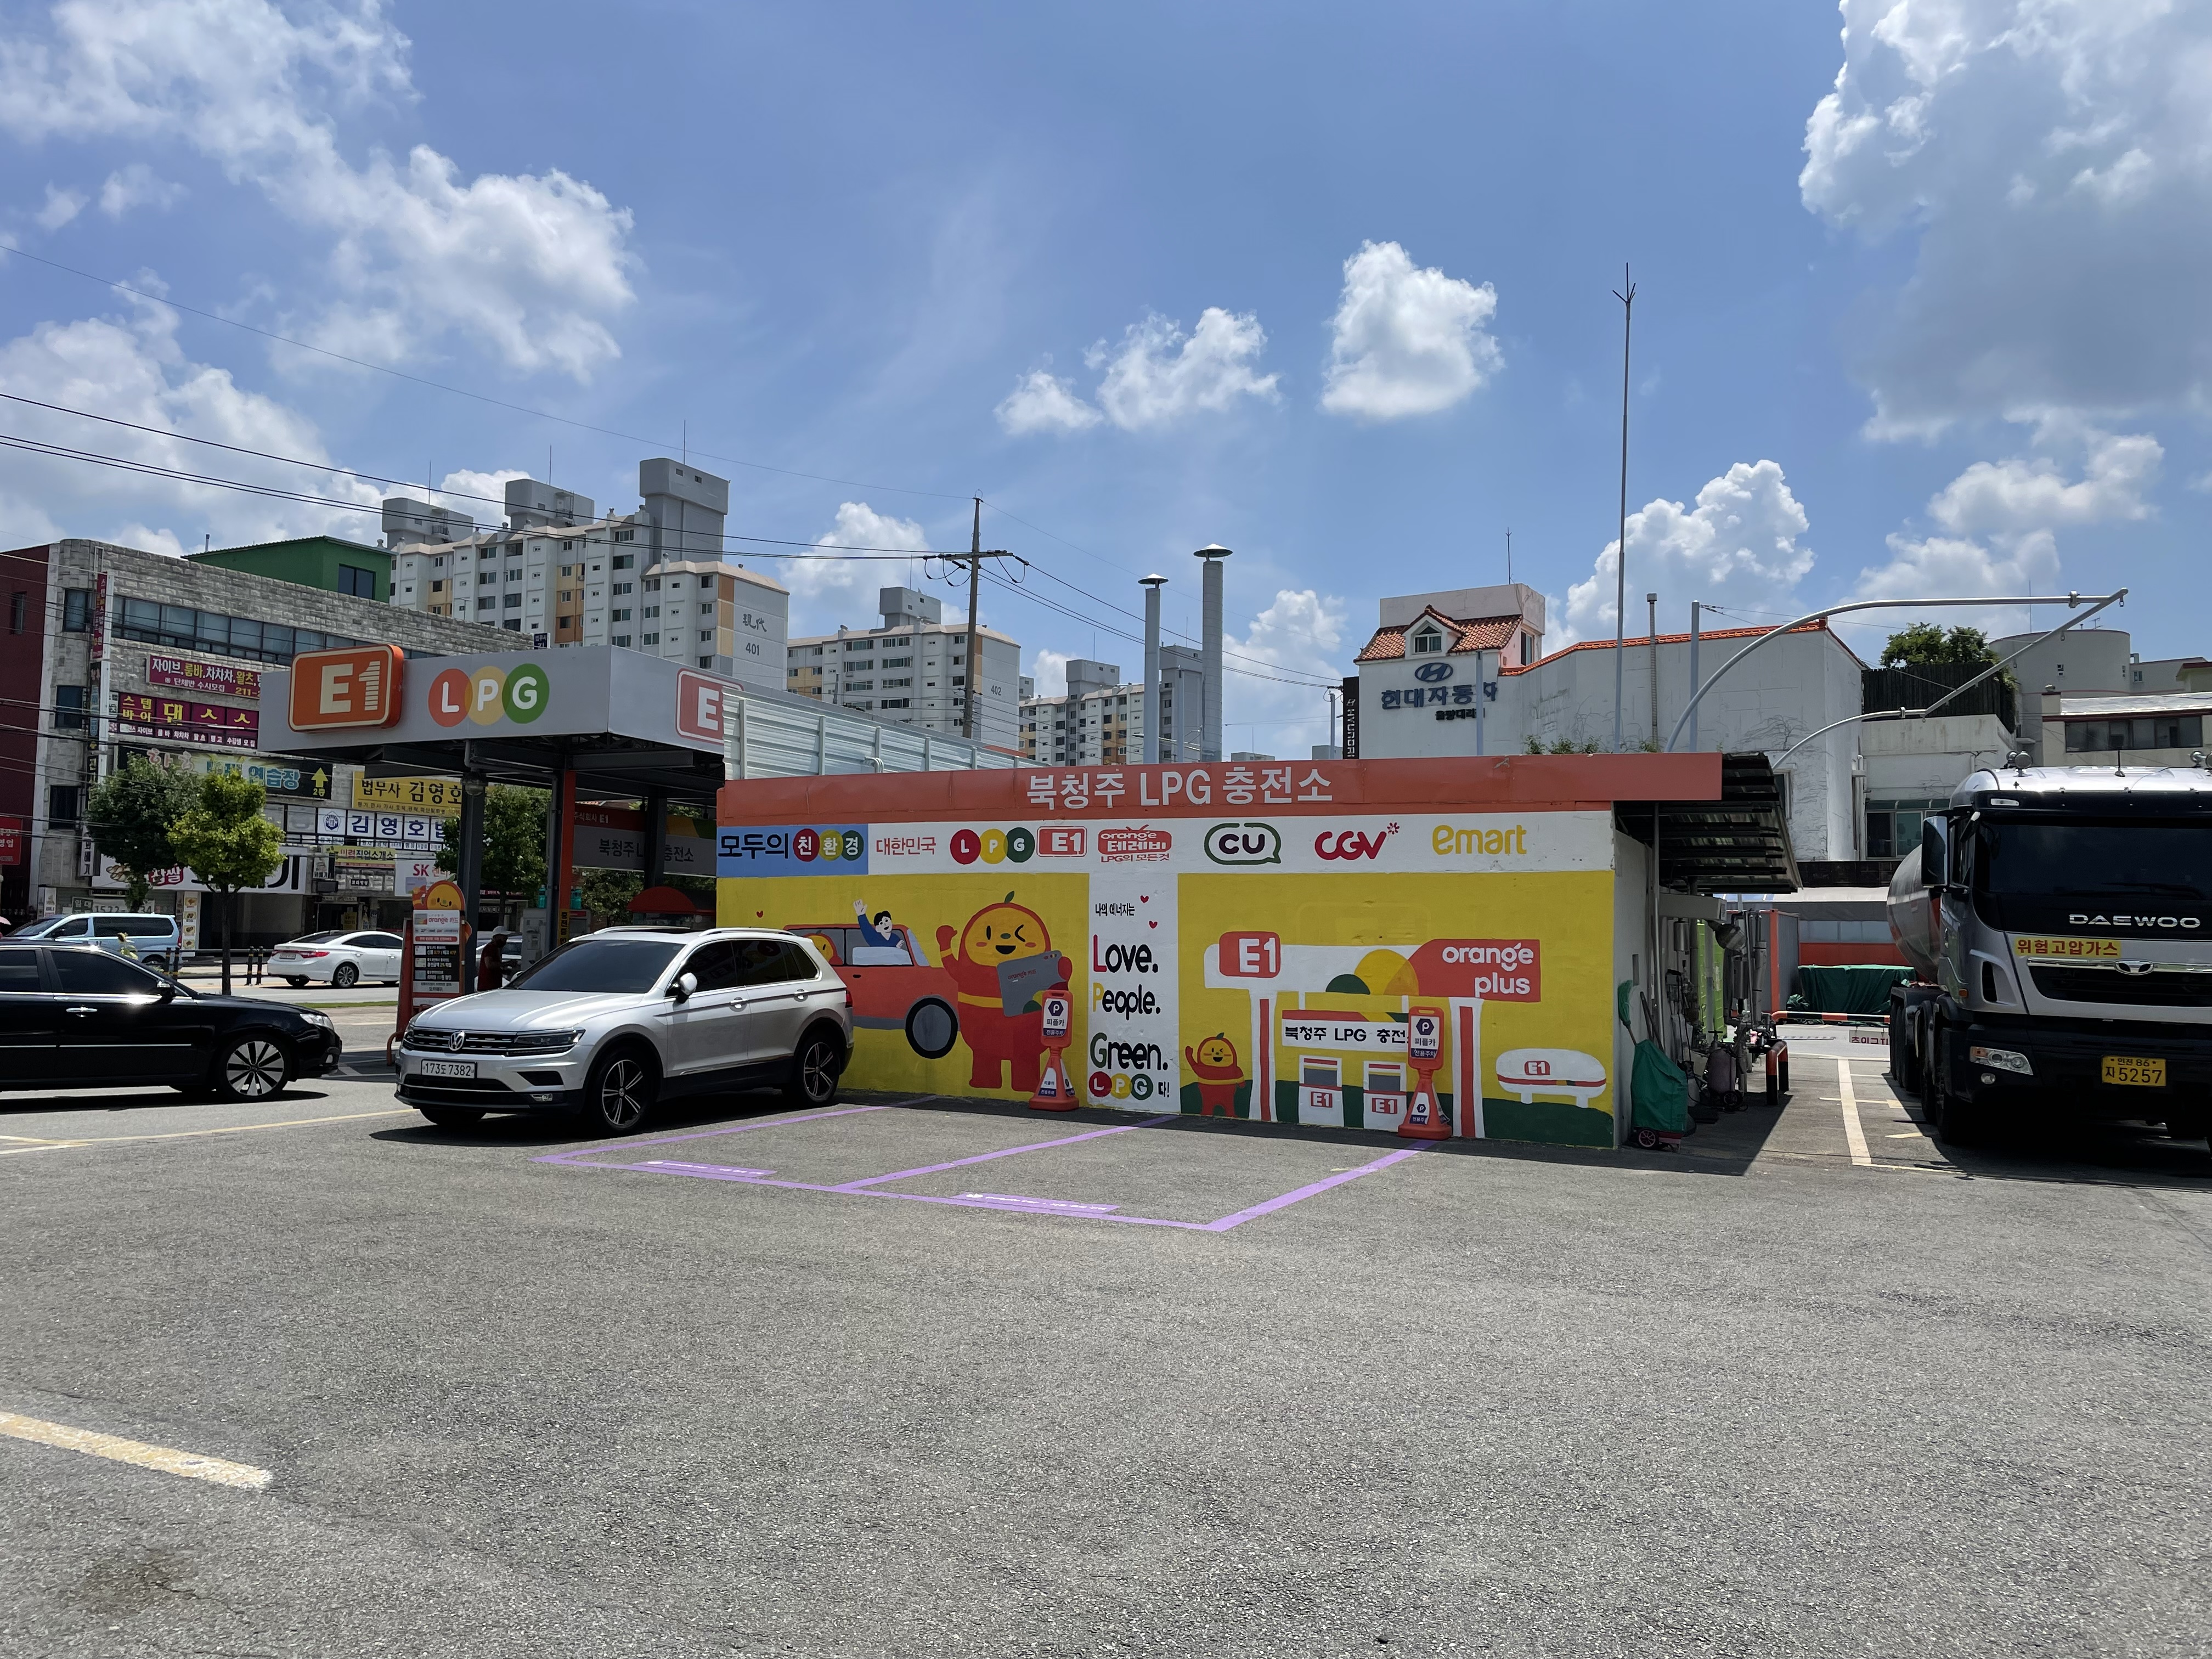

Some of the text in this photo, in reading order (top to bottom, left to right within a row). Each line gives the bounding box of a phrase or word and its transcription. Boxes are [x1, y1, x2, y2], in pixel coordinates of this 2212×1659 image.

[745, 642, 759, 656] 401
[197, 682, 225, 692] 수시모집
[319, 661, 380, 715] E1
[441, 676, 538, 714] LPG
[991, 684, 1002, 696] 402
[1381, 681, 1498, 710] 현대자동차
[122, 709, 151, 723] 바이
[1346, 708, 1356, 758] HYUNDAI
[362, 778, 462, 805] 법무사 김영호
[1027, 766, 1333, 810] 북청주 LPG 충전소
[599, 814, 609, 823] E1
[876, 832, 1082, 855] 대한민국 LPG E1
[1100, 831, 1158, 840] orange
[1218, 833, 1266, 854] CU
[1431, 824, 1527, 855] emart
[599, 838, 635, 858] 북청주
[718, 832, 860, 860] 모두의 친환경
[1314, 831, 1388, 861] CGV
[1101, 853, 1170, 863] LPG의 모든것
[413, 864, 430, 877] SK
[1094, 902, 1135, 917] 나의 에너지는
[428, 917, 448, 925] orange
[2069, 913, 2201, 928] DAEWOO
[1093, 934, 1159, 973] Love.
[1238, 937, 1277, 973] E1
[2017, 939, 2119, 956] 위험고압가스
[1442, 941, 1534, 972] orange
[1474, 972, 1531, 998] plus
[1092, 982, 1162, 1021] People.
[1046, 1018, 1065, 1027] 피플카
[1285, 1026, 1408, 1044] 북청주 LPG 충전
[1414, 1037, 1436, 1047] 피플카
[1090, 1032, 1169, 1071] Green.
[1413, 1048, 1436, 1057] 전용주차
[425, 1063, 471, 1076] 173도 7382
[1527, 1061, 1548, 1075] E1
[2136, 1059, 2150, 1067] 86
[2118, 1067, 2163, 1084] 5257
[1093, 1080, 1148, 1095] LPG
[1158, 1081, 1170, 1098] 다!
[1312, 1092, 1331, 1107] E1
[1375, 1099, 1396, 1114] E1
